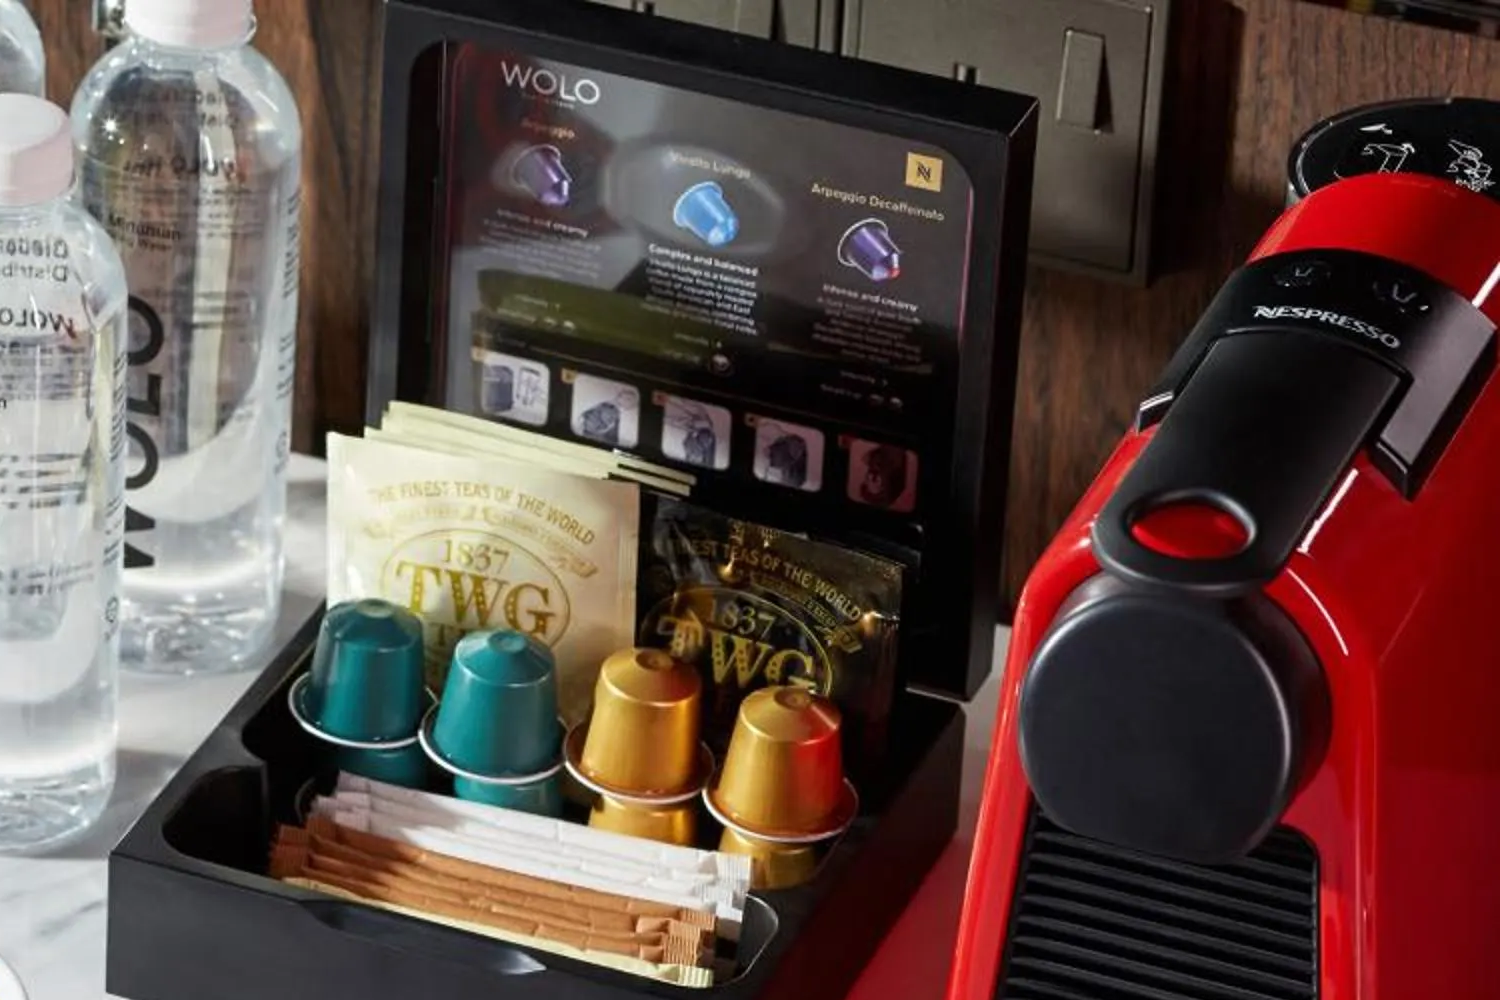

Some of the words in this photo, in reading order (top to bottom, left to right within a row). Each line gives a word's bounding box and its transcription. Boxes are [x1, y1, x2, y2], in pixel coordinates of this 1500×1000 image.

[502, 60, 600, 104] WOLO
[811, 182, 867, 206] Arpeggio
[869, 195, 946, 222] Decaffeinato
[1253, 304, 1402, 349] NESPRESSO
[400, 479, 450, 499] FINEST
[453, 480, 491, 500] TEAS
[494, 486, 514, 502] OF
[517, 492, 546, 518] THE
[547, 508, 597, 546] WORLD
[443, 538, 510, 574] 1837
[395, 559, 557, 638] TWG
[762, 554, 781, 573] OF
[782, 561, 811, 588] THE
[814, 577, 863, 622] WORLD
